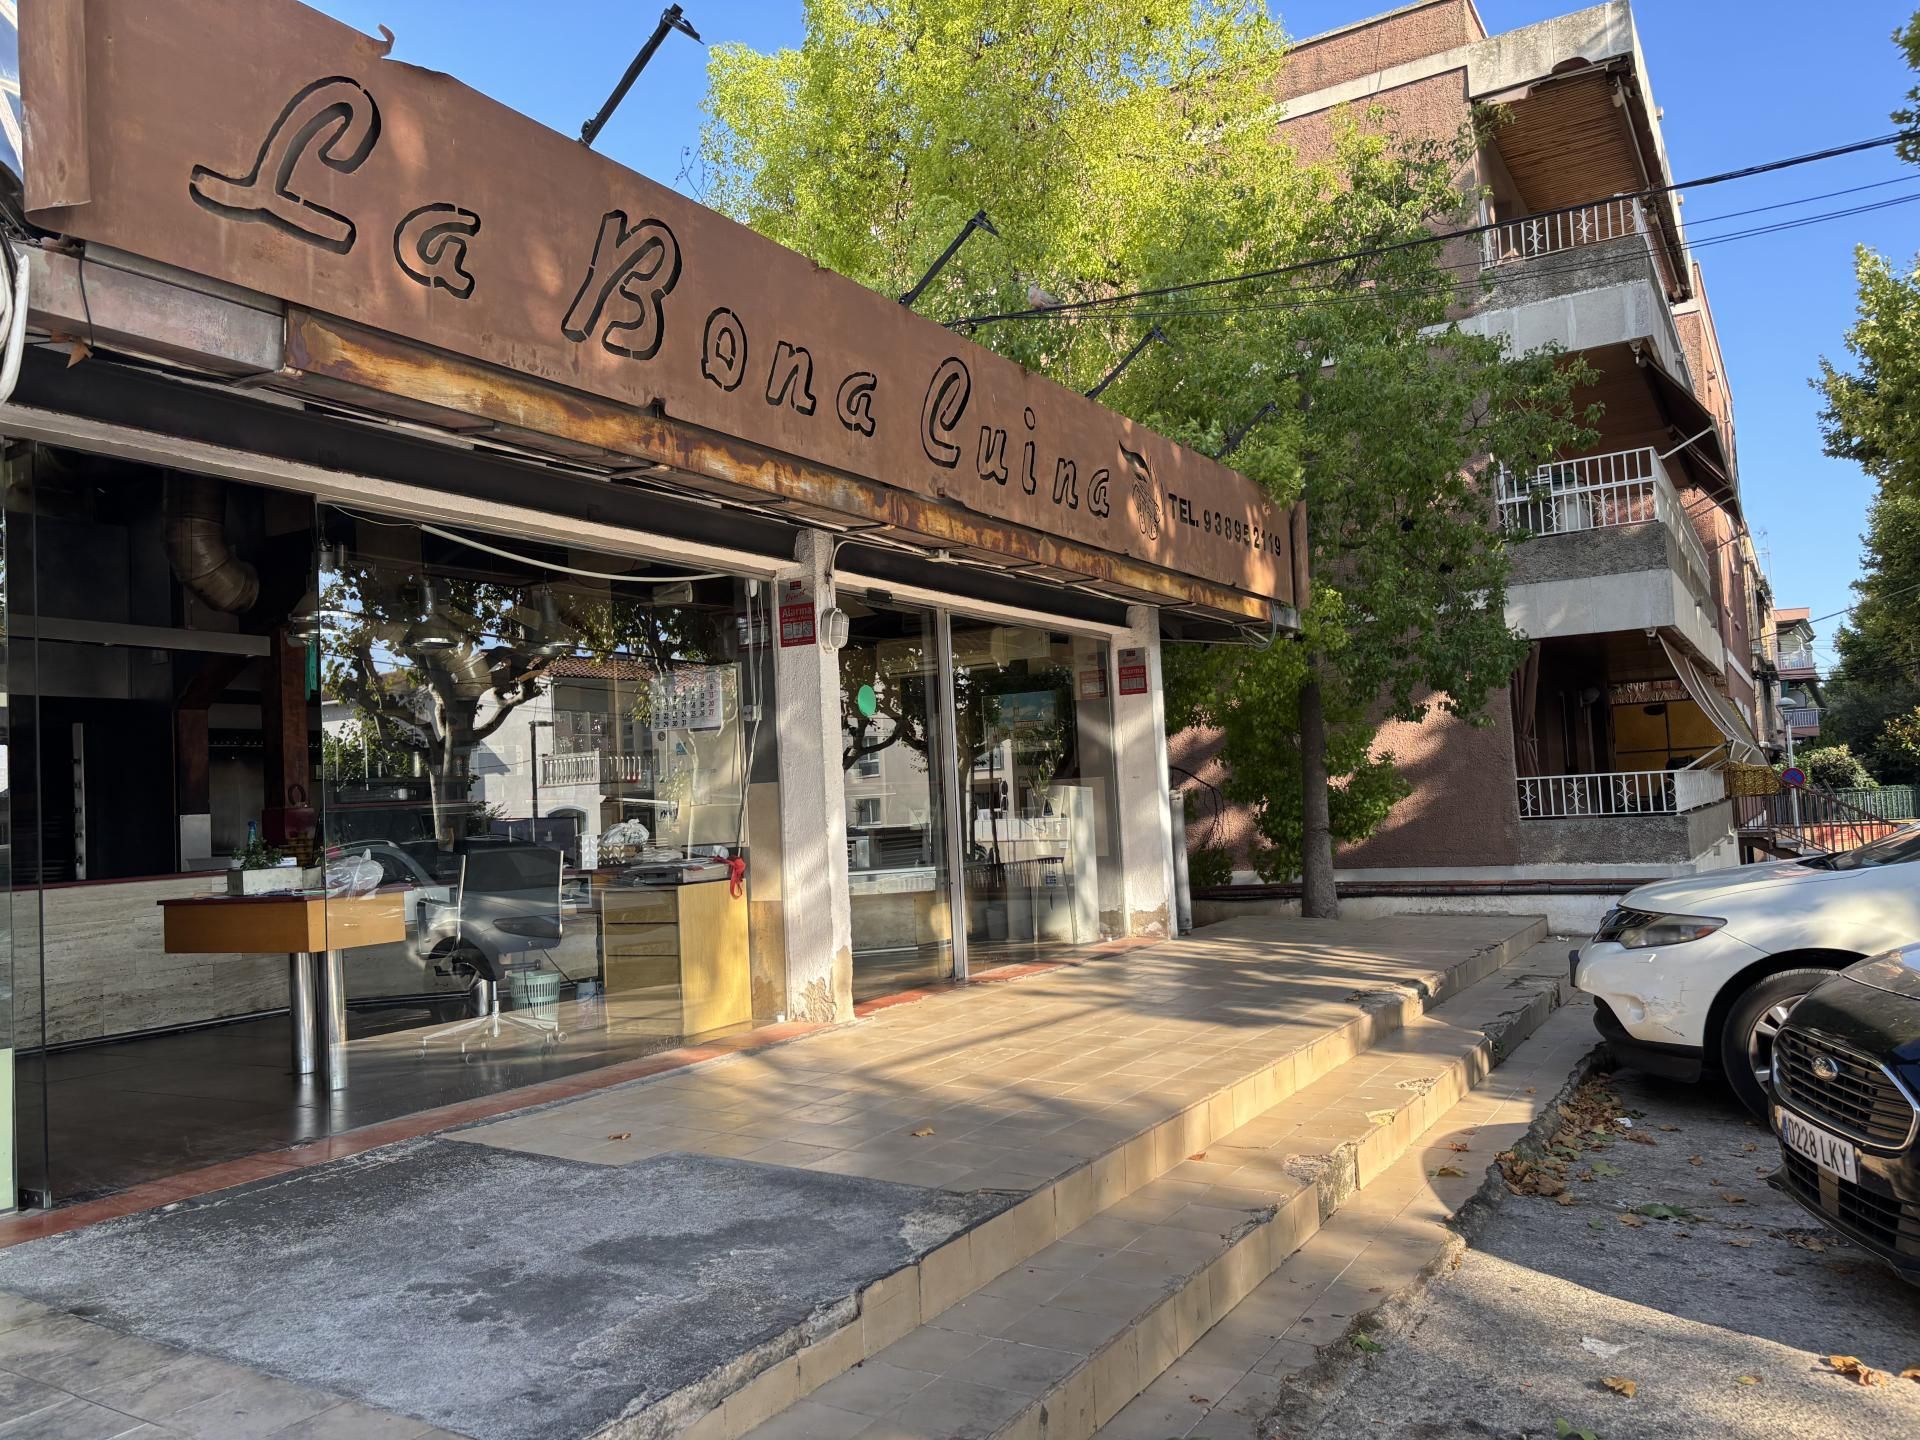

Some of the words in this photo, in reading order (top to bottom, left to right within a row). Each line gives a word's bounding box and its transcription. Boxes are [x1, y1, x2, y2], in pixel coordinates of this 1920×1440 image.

[189, 75, 481, 299] La
[561, 209, 877, 438] Bona
[920, 356, 1110, 518] Cuina
[1168, 493, 1199, 528] TEL.
[782, 606, 813, 617] Alarma
[1788, 1117, 1817, 1159] 0228
[1820, 1135, 1847, 1176] LKY
